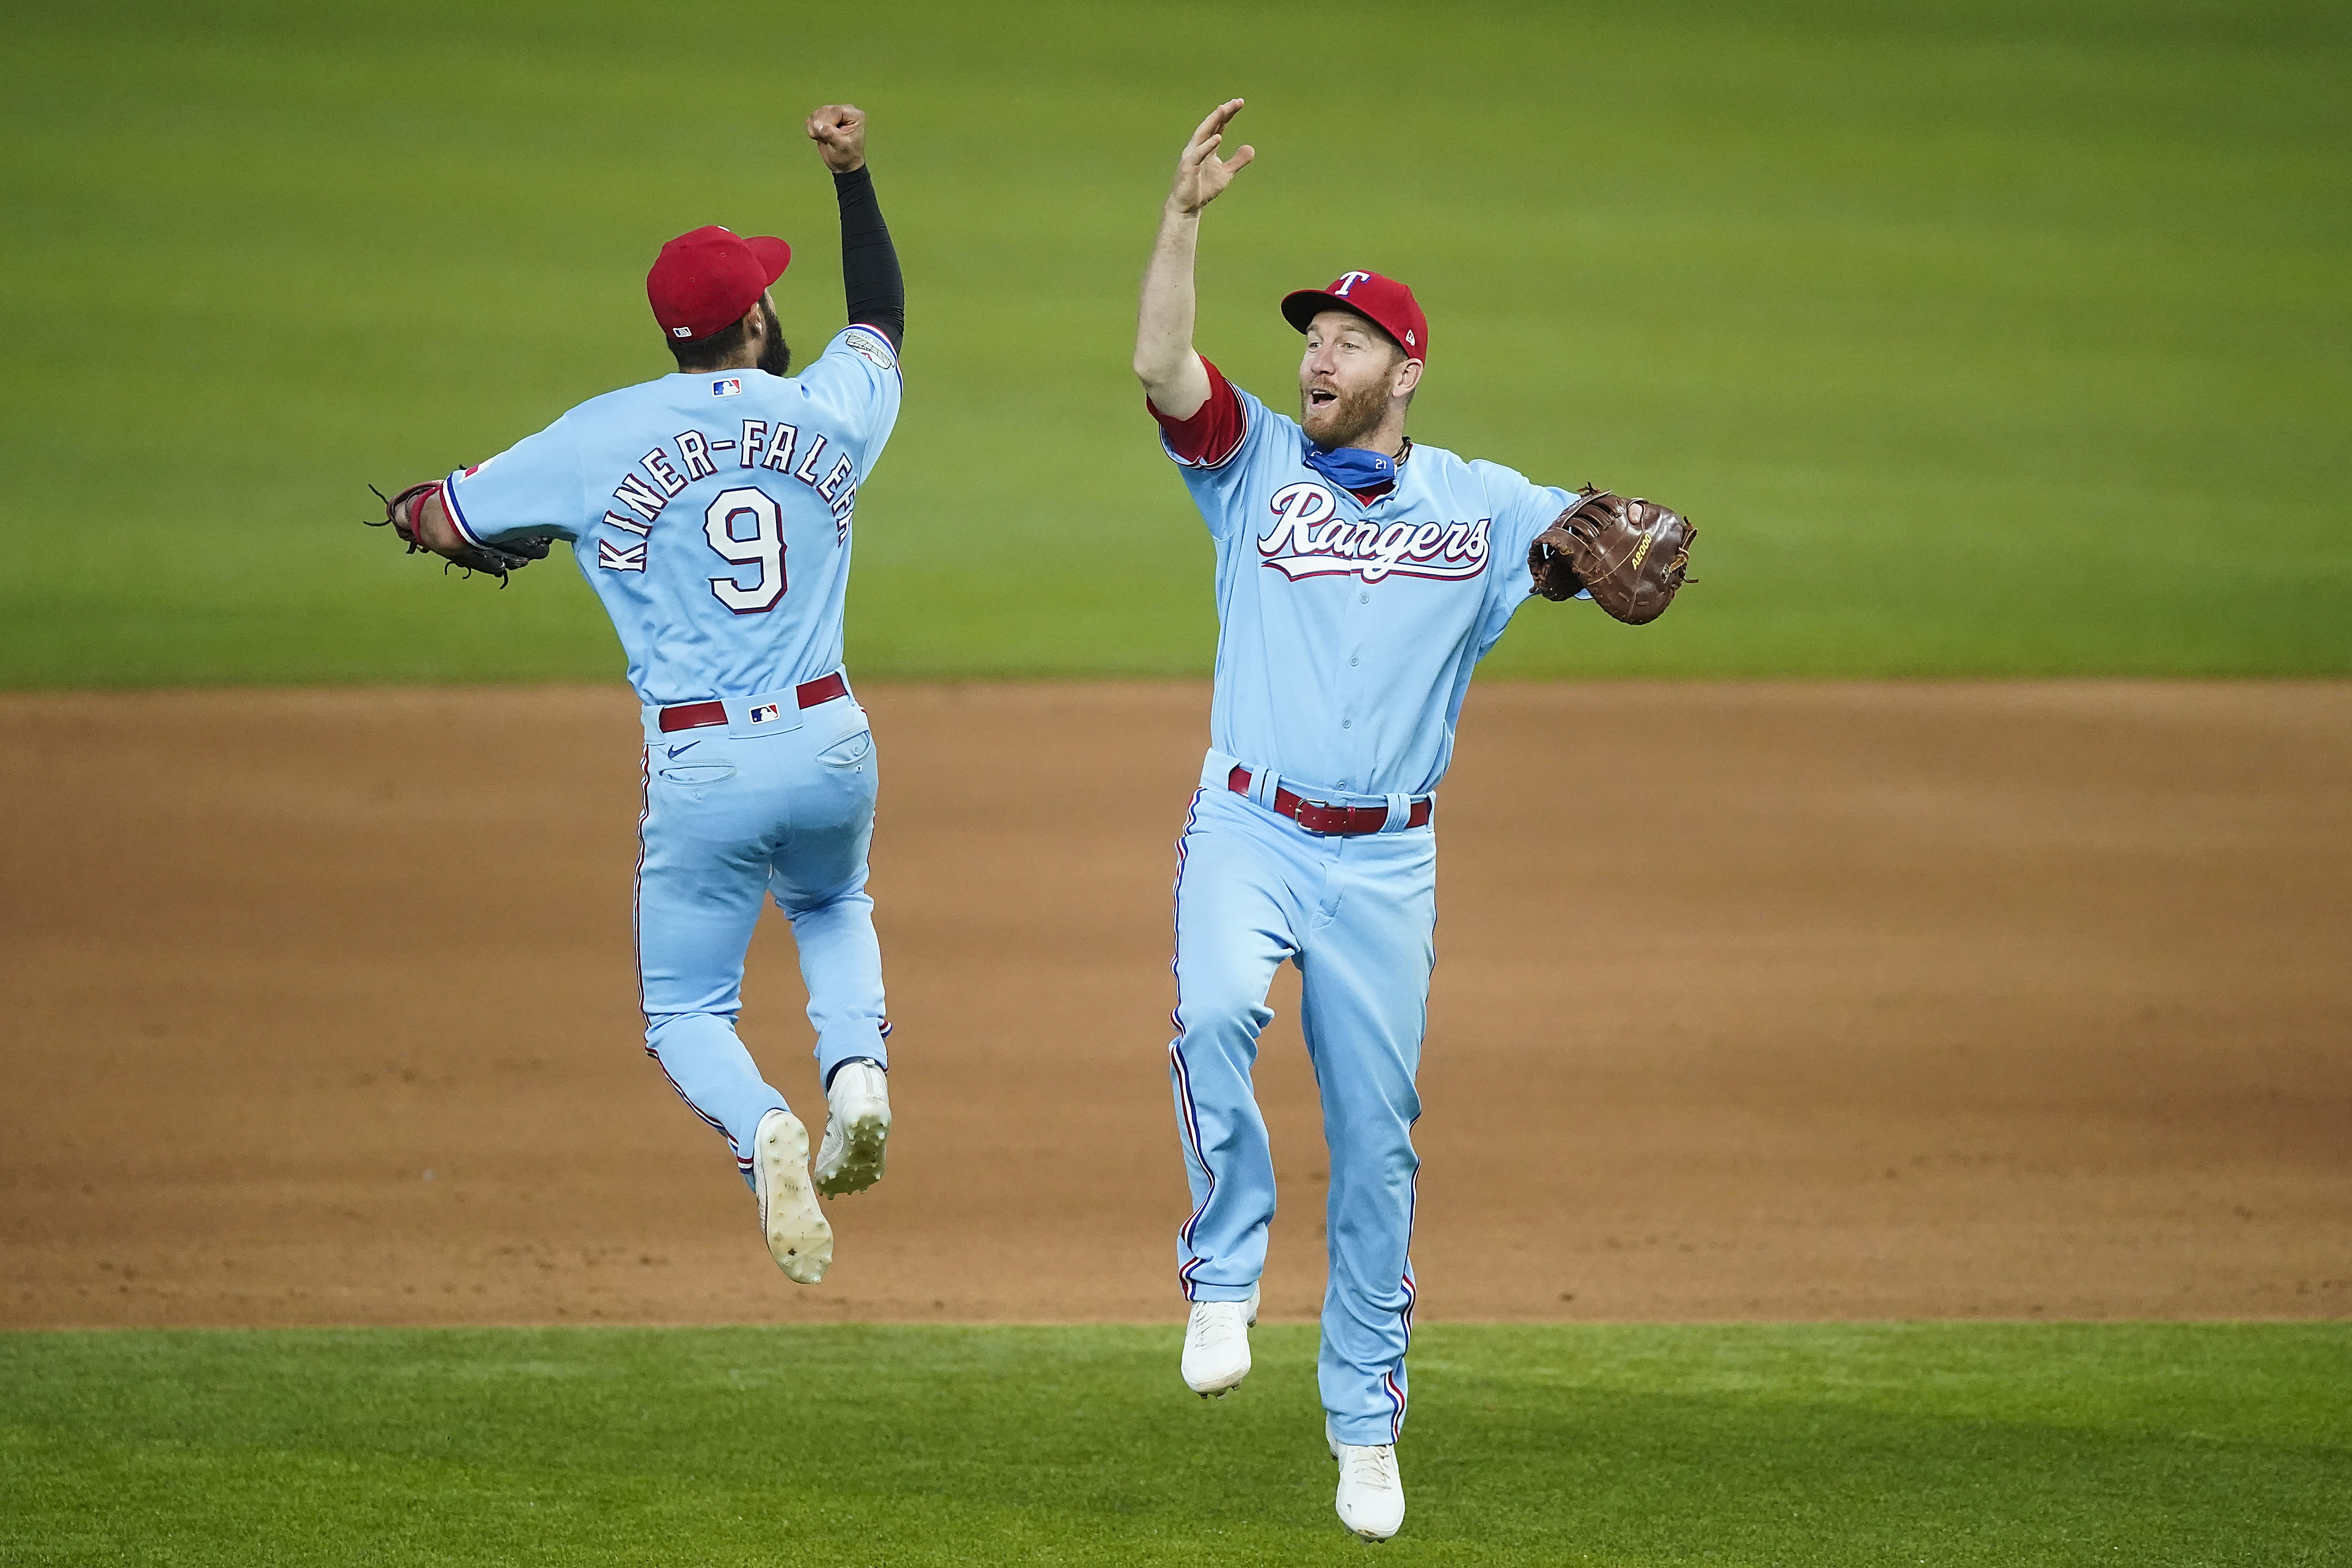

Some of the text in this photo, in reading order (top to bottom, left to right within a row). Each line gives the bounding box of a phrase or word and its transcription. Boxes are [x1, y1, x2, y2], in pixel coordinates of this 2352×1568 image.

[1335, 270, 1370, 298] T
[1375, 458, 1387, 469] 21
[702, 486, 788, 615] 9
[1257, 482, 1491, 584] Rangers
[1631, 533, 1652, 570] A2000
